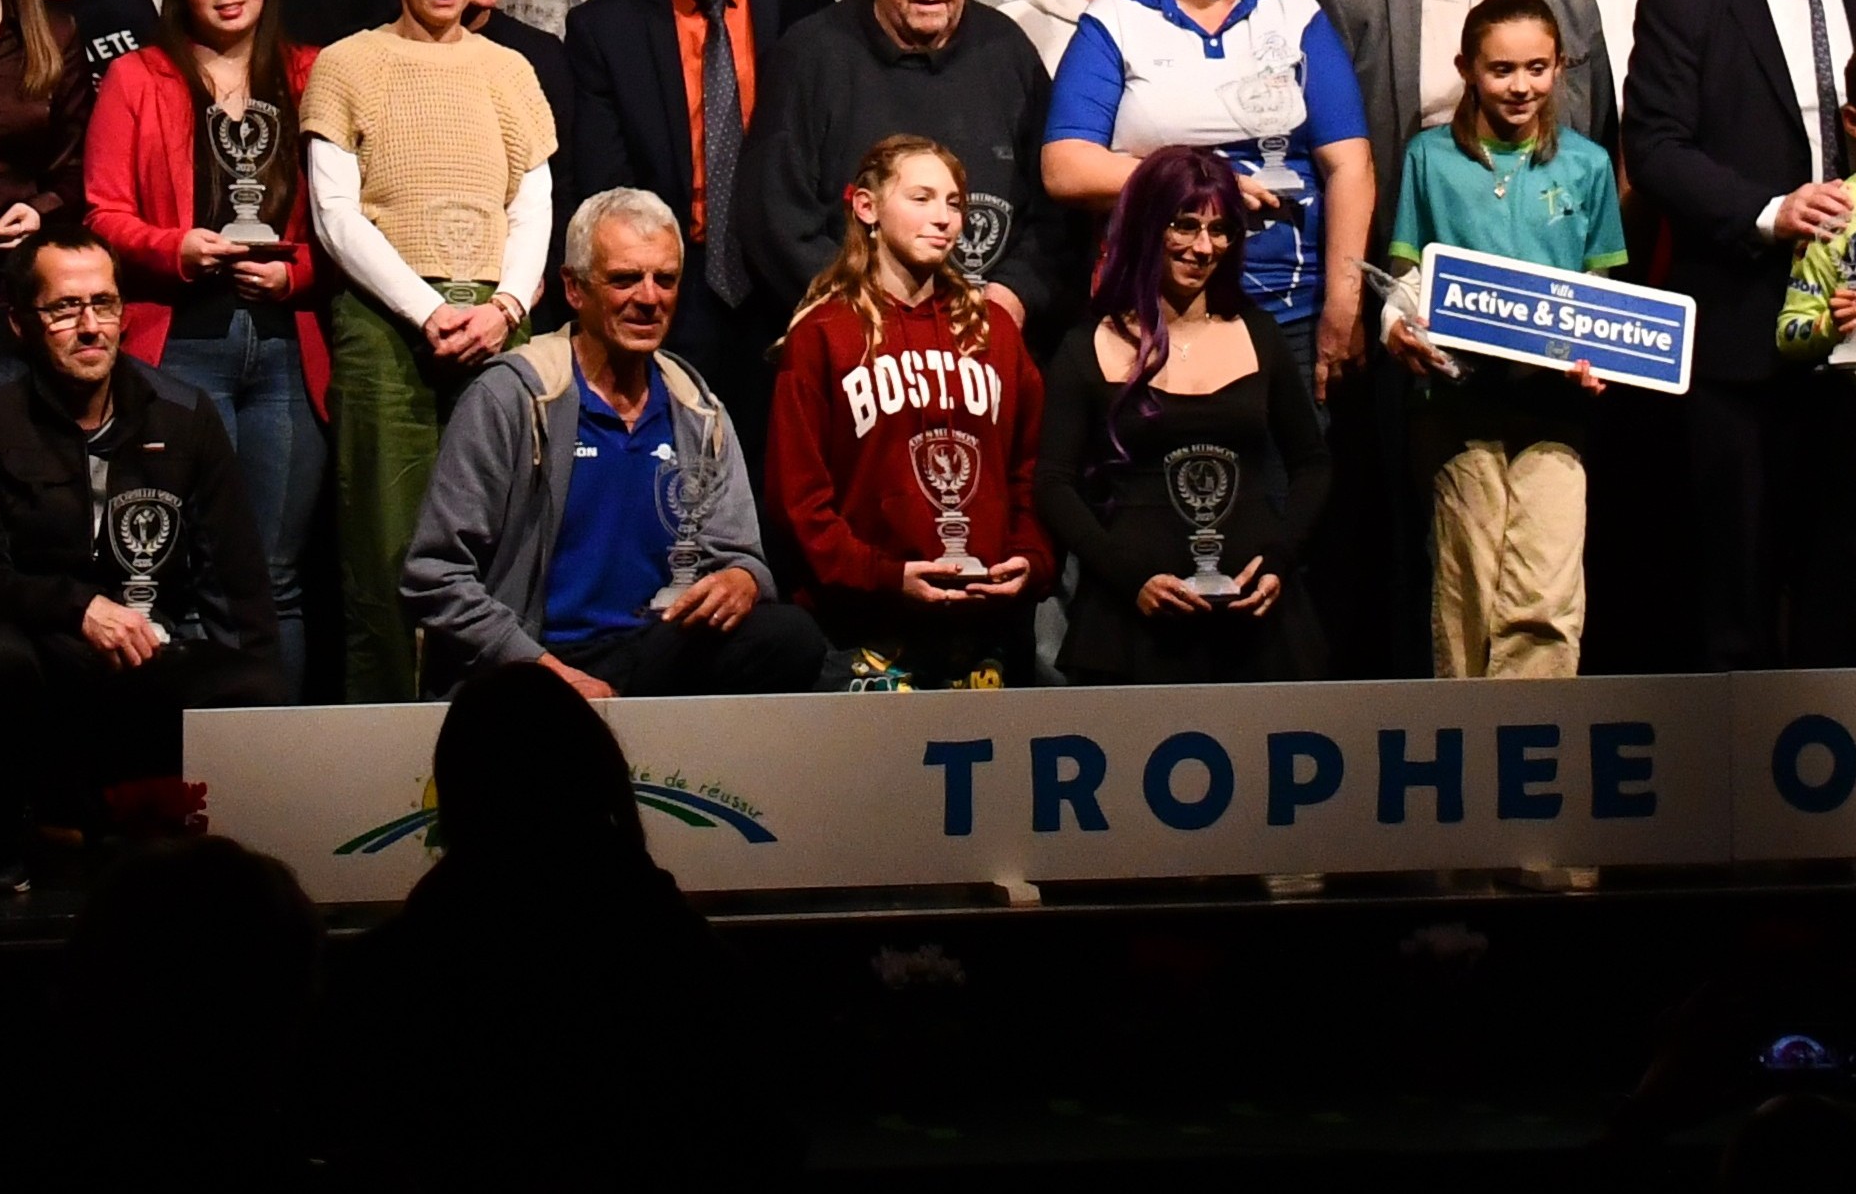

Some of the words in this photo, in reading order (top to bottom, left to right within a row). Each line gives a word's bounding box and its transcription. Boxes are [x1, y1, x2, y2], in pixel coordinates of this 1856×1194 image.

[1443, 282, 1529, 318] Active
[1532, 300, 1554, 327] &
[1558, 304, 1673, 351] Sportive
[664, 768, 688, 789] de
[921, 720, 1659, 837] TROPHEE
